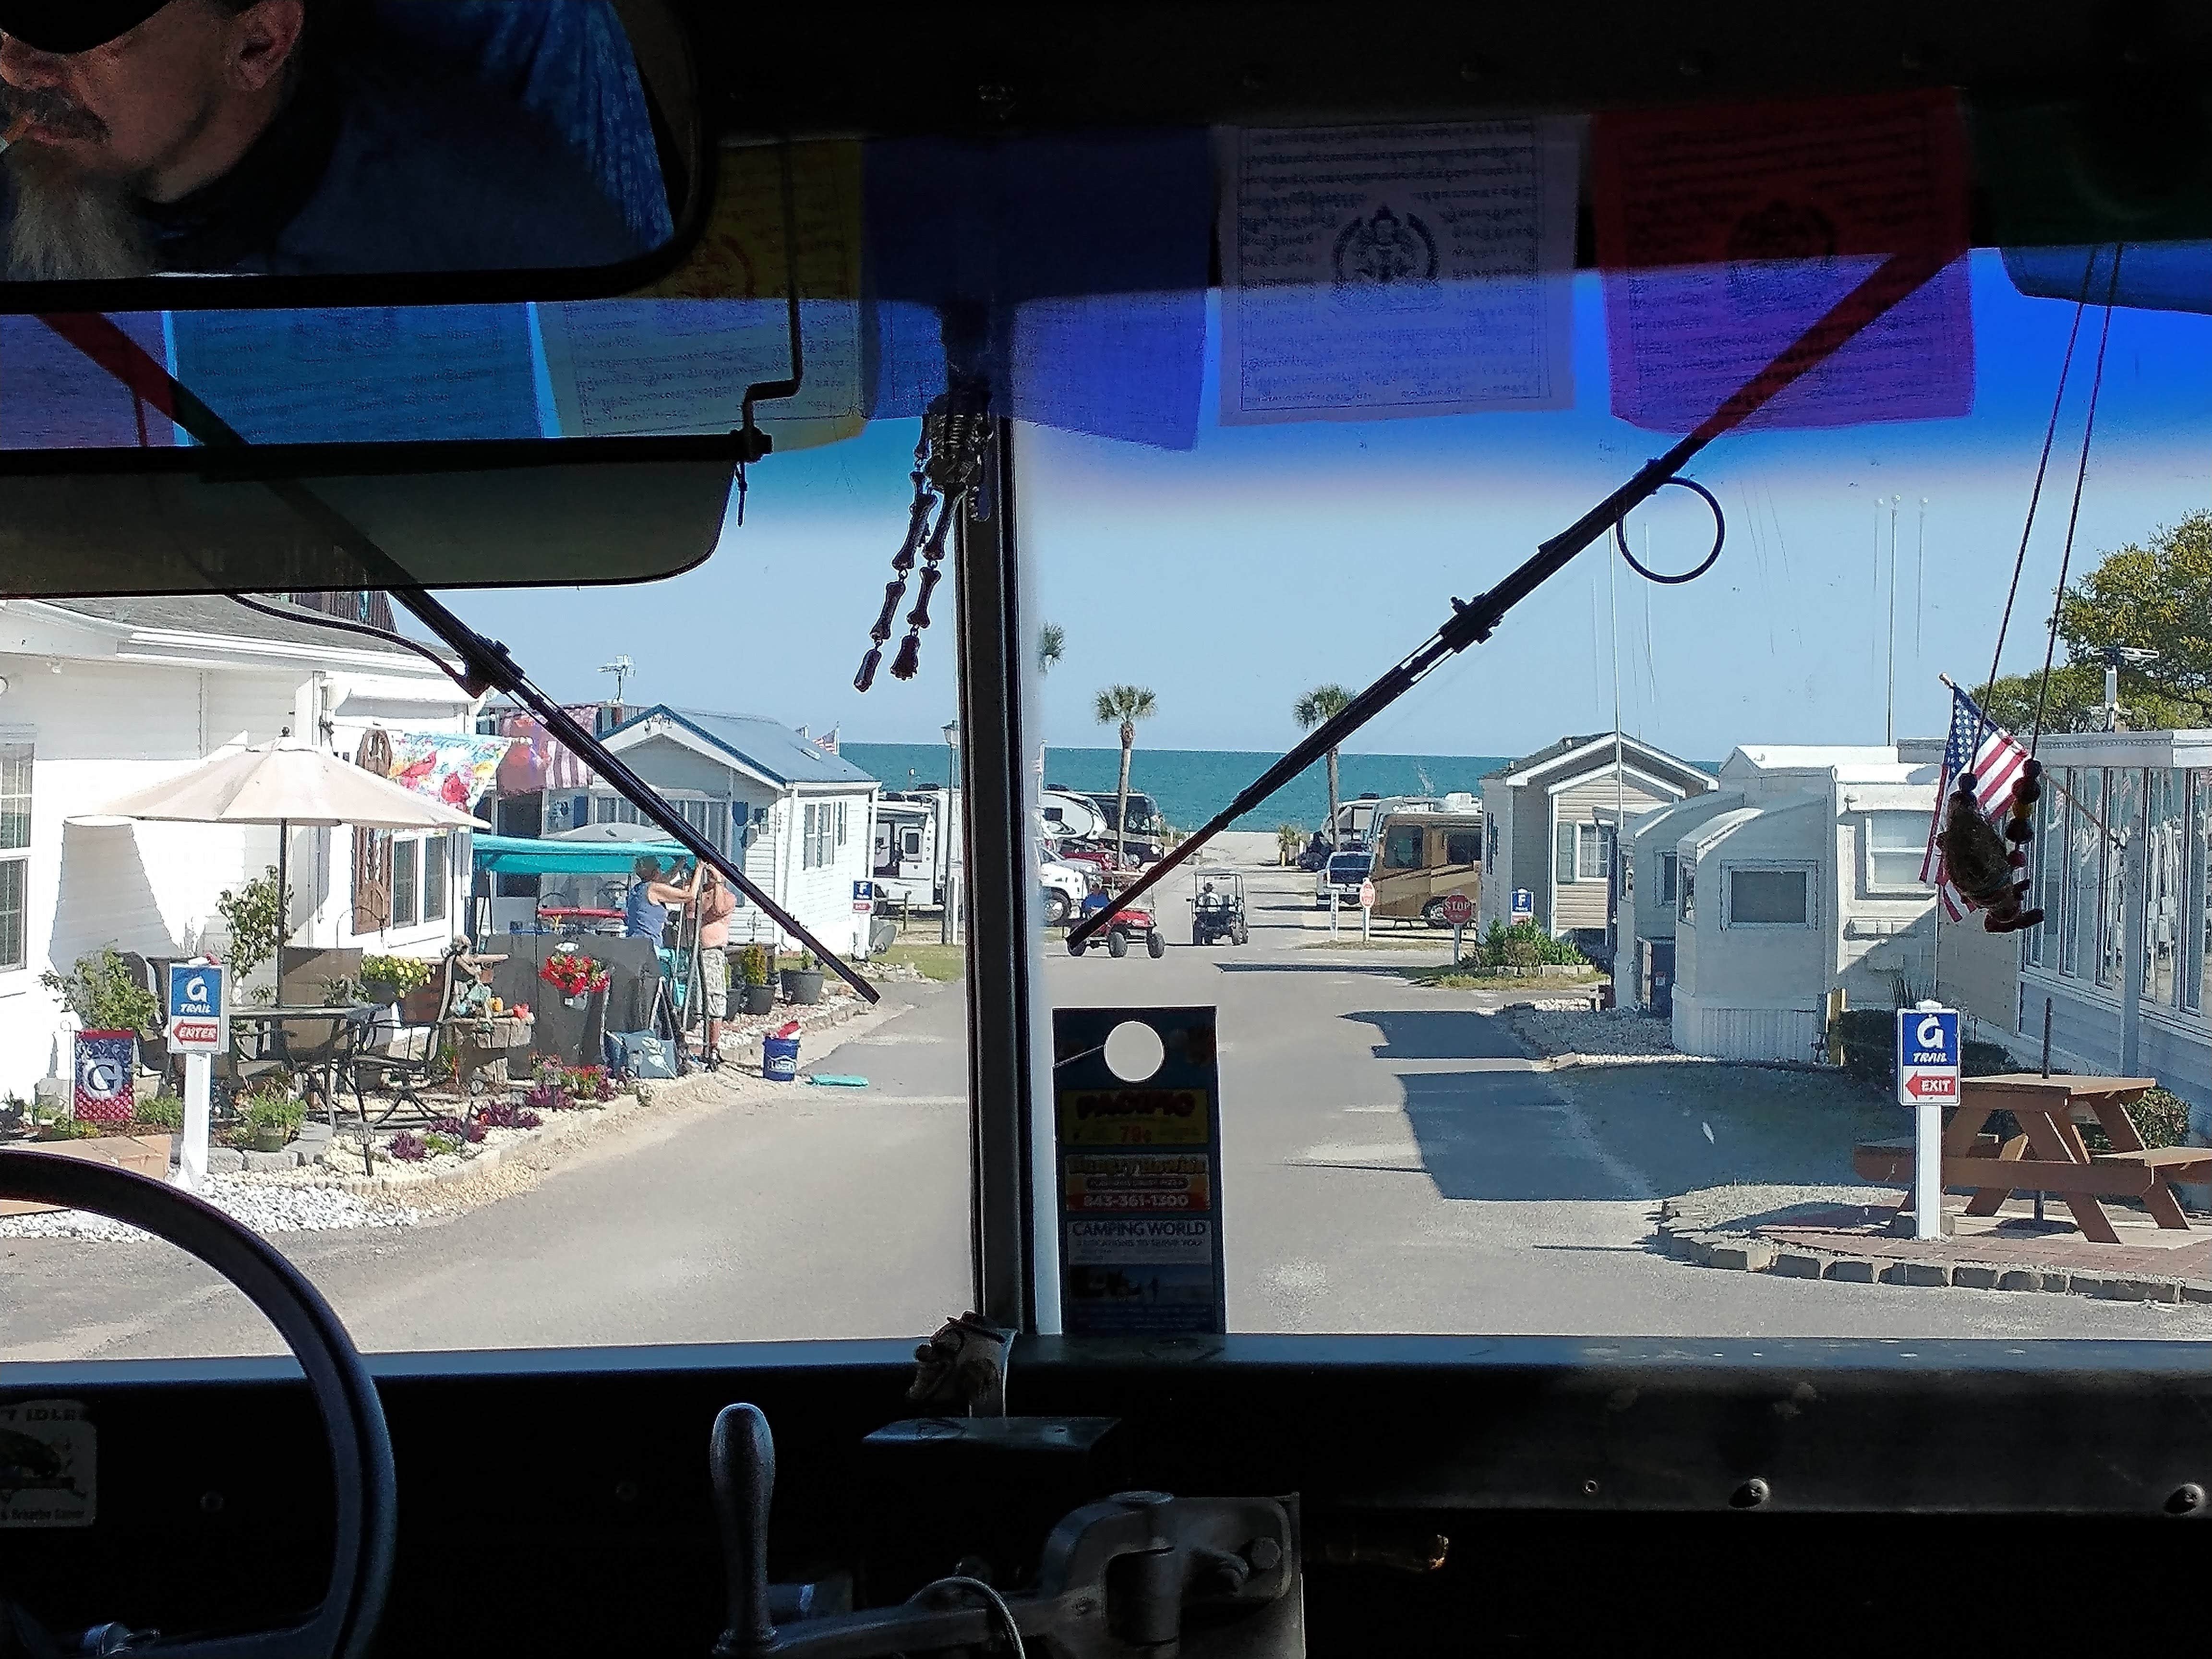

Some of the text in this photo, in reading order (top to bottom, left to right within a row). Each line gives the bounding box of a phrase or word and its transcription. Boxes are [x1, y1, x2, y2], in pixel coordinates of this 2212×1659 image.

[1445, 902, 1470, 911] STOP
[179, 1003, 211, 1013] TRAIL
[179, 1027, 216, 1039] ENTER
[1917, 1016, 1944, 1049] G
[1913, 1052, 1947, 1062] TRAIL
[87, 1064, 118, 1091] G
[1921, 1079, 1951, 1092] EXIT
[1072, 1222, 1206, 1236] CAMPING WORLD
